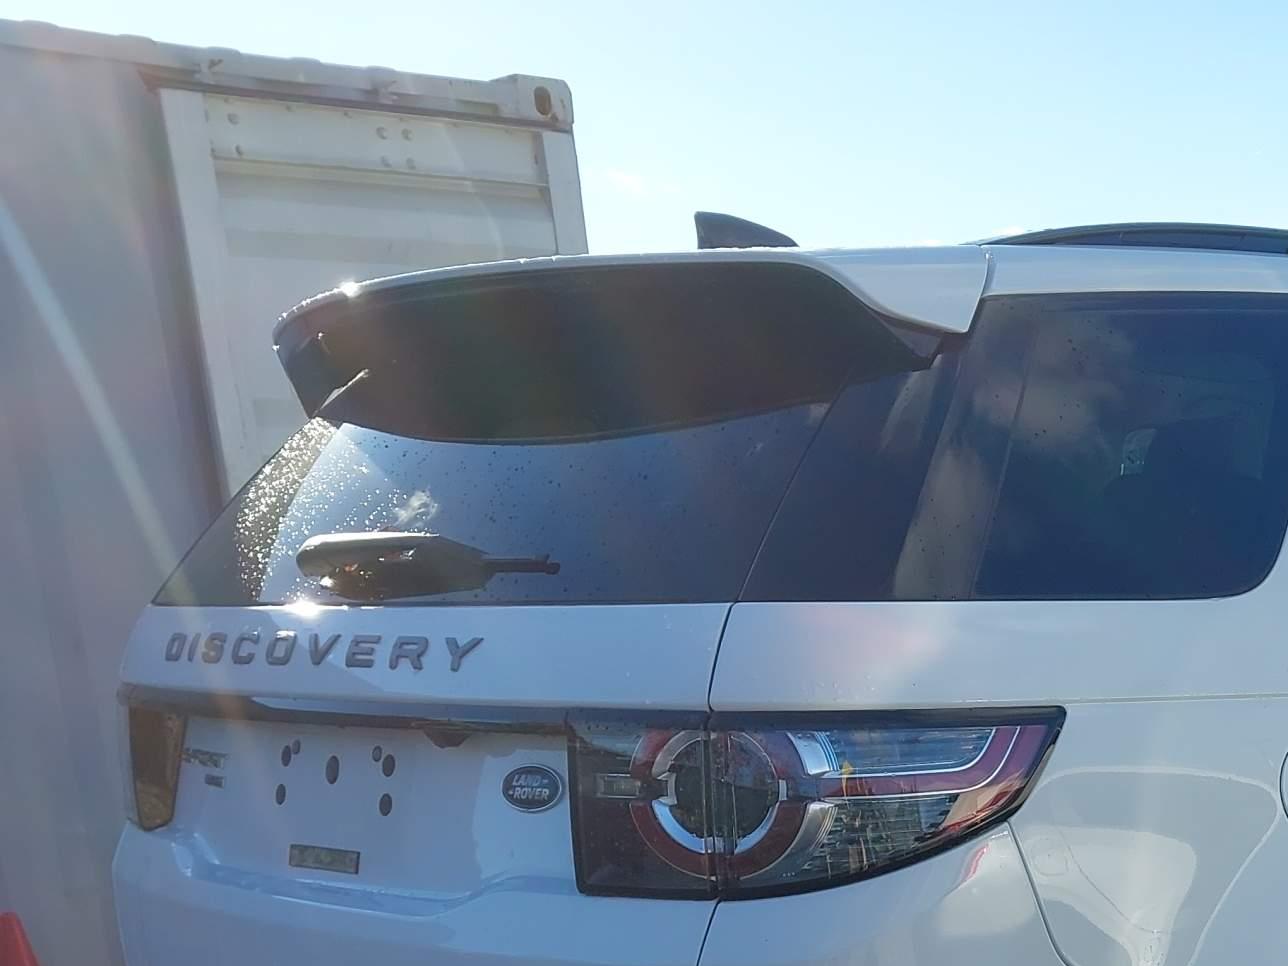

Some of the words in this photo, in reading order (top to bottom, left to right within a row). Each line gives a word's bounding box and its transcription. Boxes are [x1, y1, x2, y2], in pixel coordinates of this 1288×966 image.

[164, 630, 485, 672] DISCOVERY
[512, 774, 542, 786] LAND
[513, 787, 550, 800] ROVER
